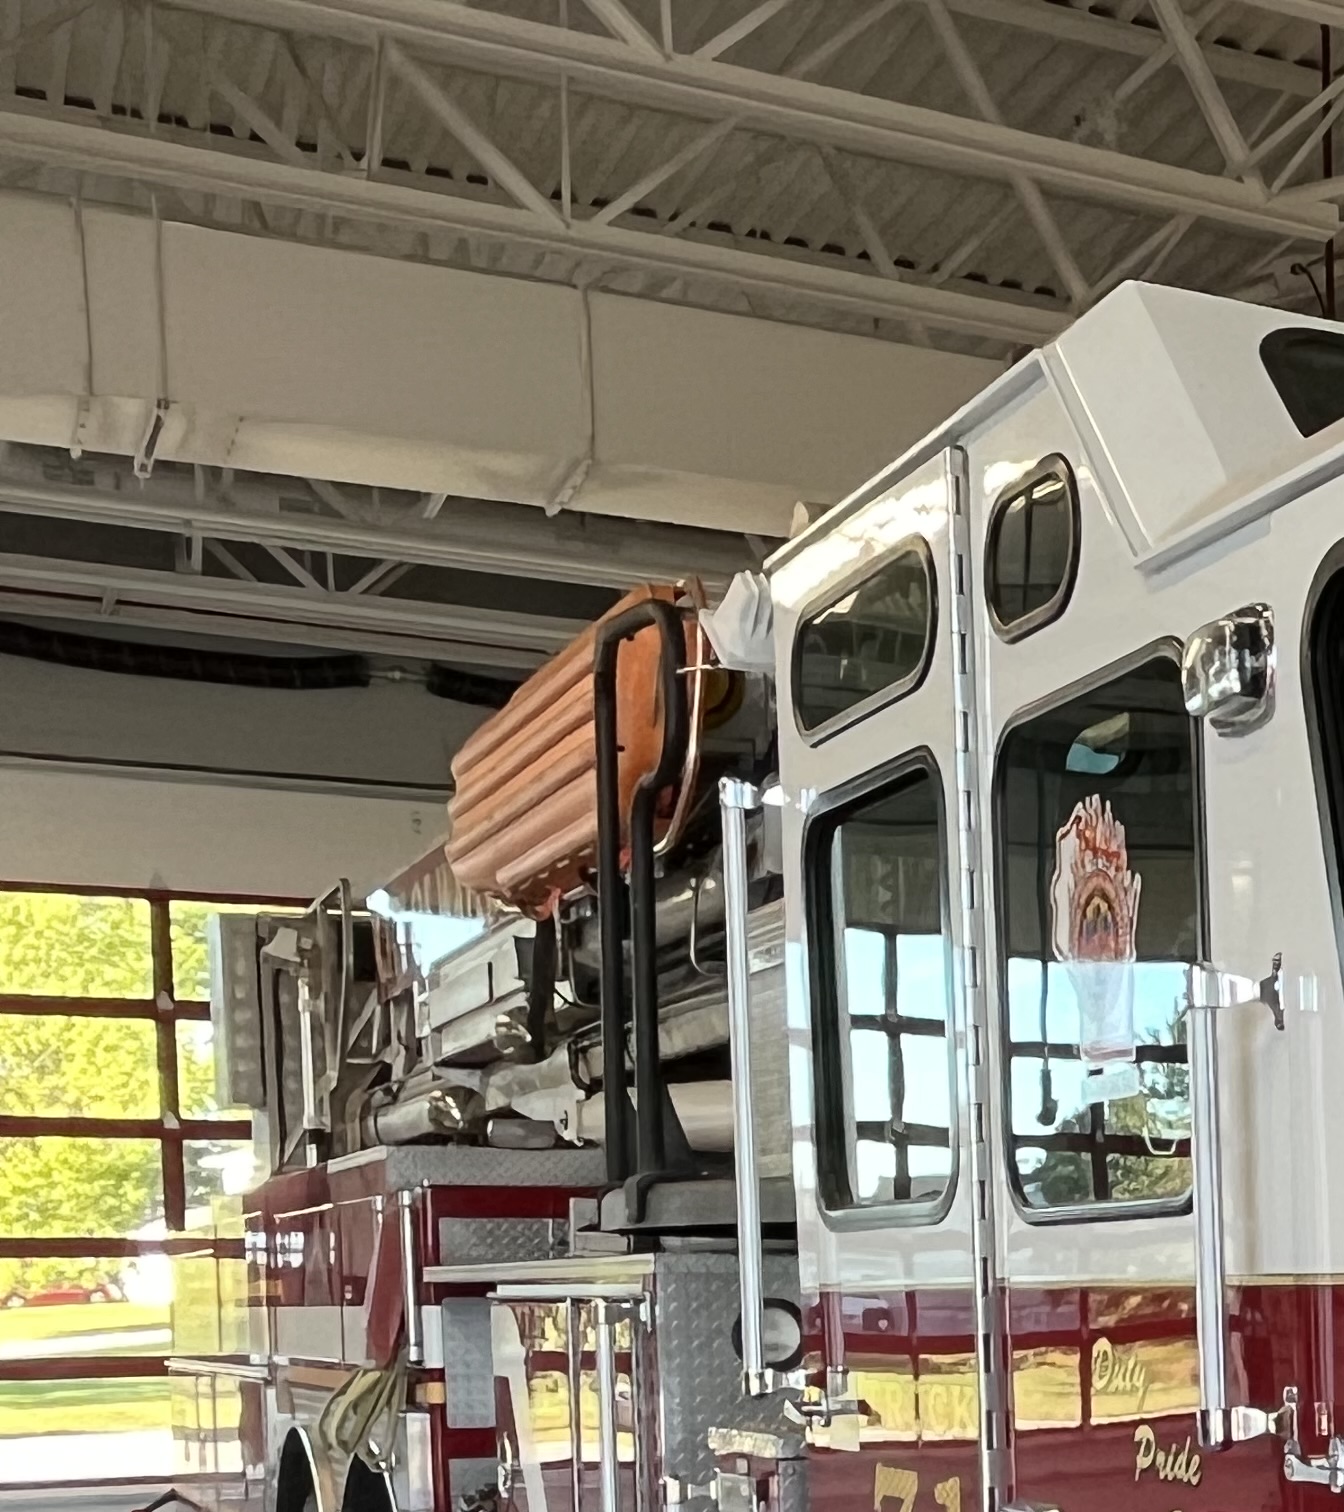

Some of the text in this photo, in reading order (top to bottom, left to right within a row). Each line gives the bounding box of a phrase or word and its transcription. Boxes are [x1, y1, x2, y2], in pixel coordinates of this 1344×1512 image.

[864, 1373, 979, 1436] TRCK
[1092, 1336, 1147, 1412] Duty
[1133, 1424, 1202, 1487] Pride
